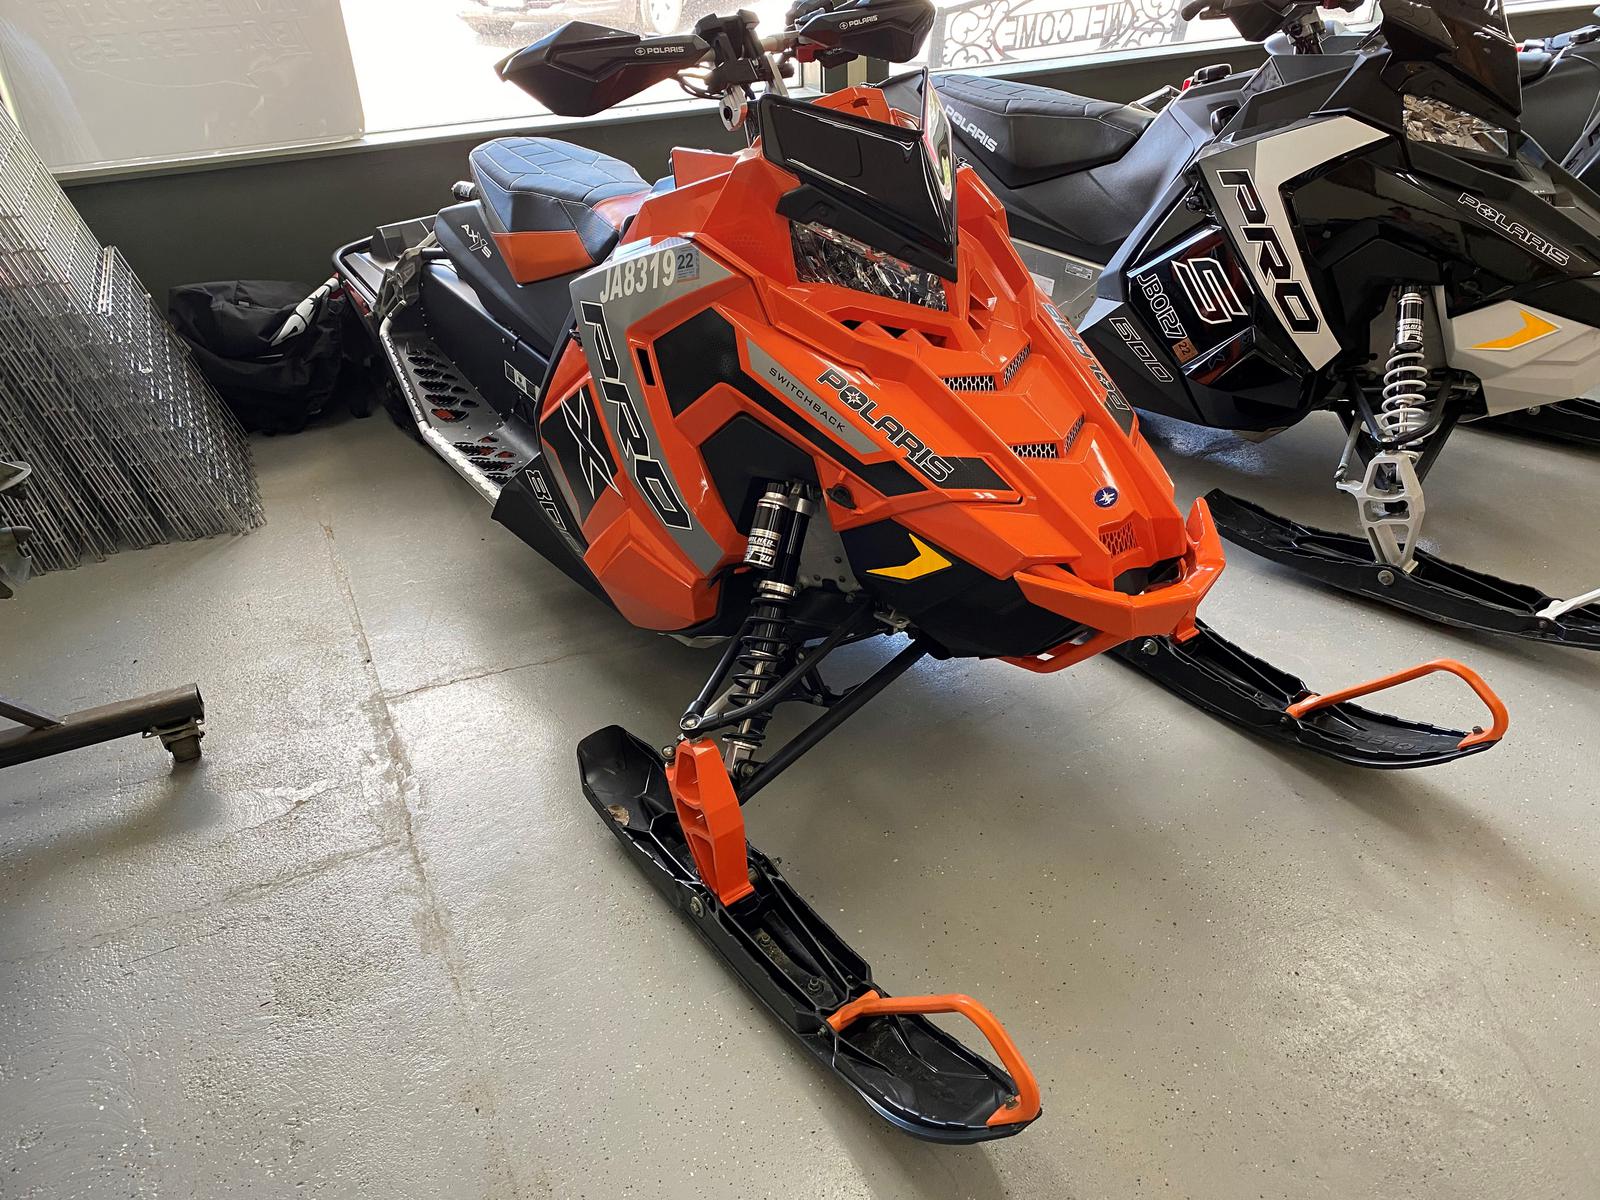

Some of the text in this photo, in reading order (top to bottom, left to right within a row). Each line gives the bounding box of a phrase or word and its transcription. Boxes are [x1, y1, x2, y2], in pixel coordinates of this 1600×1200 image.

[646, 46, 685, 54] POLARIS
[848, 15, 879, 27] POLARIS
[944, 104, 998, 153] POLARIS
[677, 253, 694, 270] 22
[1216, 169, 1321, 334] PRO
[1458, 192, 1570, 266] POLARIS
[600, 249, 676, 304] JA8319
[1136, 273, 1188, 339] JB0127
[1042, 303, 1130, 411] POLARIS
[1178, 341, 1192, 356] 22
[580, 301, 692, 530] PRO
[769, 367, 847, 433] SWITCHBACK
[816, 367, 955, 483] POLARIS
[561, 388, 623, 500] X
